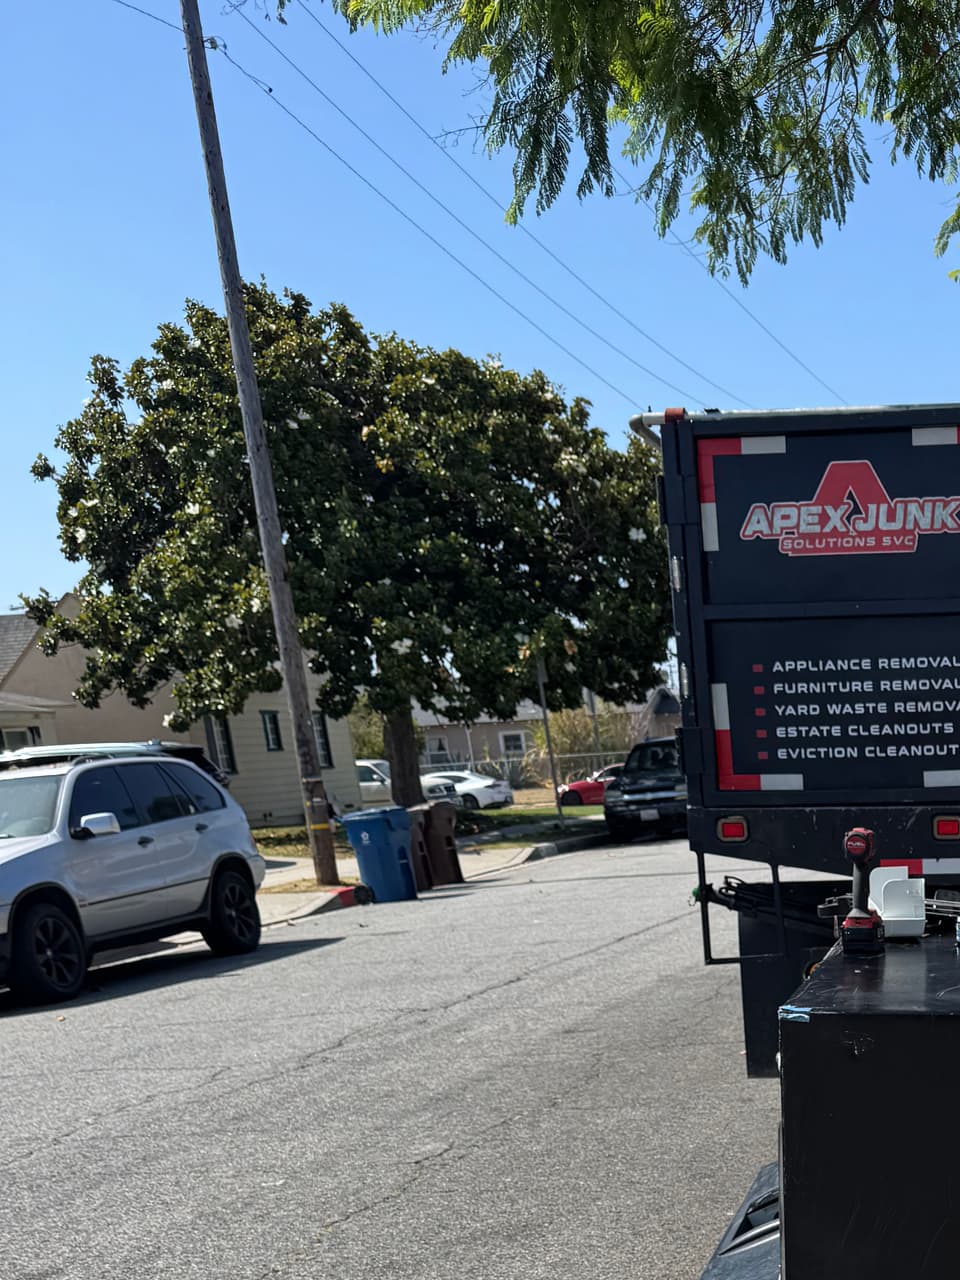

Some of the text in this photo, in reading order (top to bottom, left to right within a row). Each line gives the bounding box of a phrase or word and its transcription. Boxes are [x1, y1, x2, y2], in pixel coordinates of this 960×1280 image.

[744, 501, 960, 535] APEX JUNK
[783, 535, 914, 549] SOLUTIONS SVC
[773, 658, 871, 673] APPLIANCE
[773, 680, 873, 694] FURNITURE
[775, 704, 820, 716] YARD
[827, 702, 887, 715] WASTE
[776, 722, 954, 738] ESTATE CLEANOUTS
[777, 747, 858, 759] EVICTION
